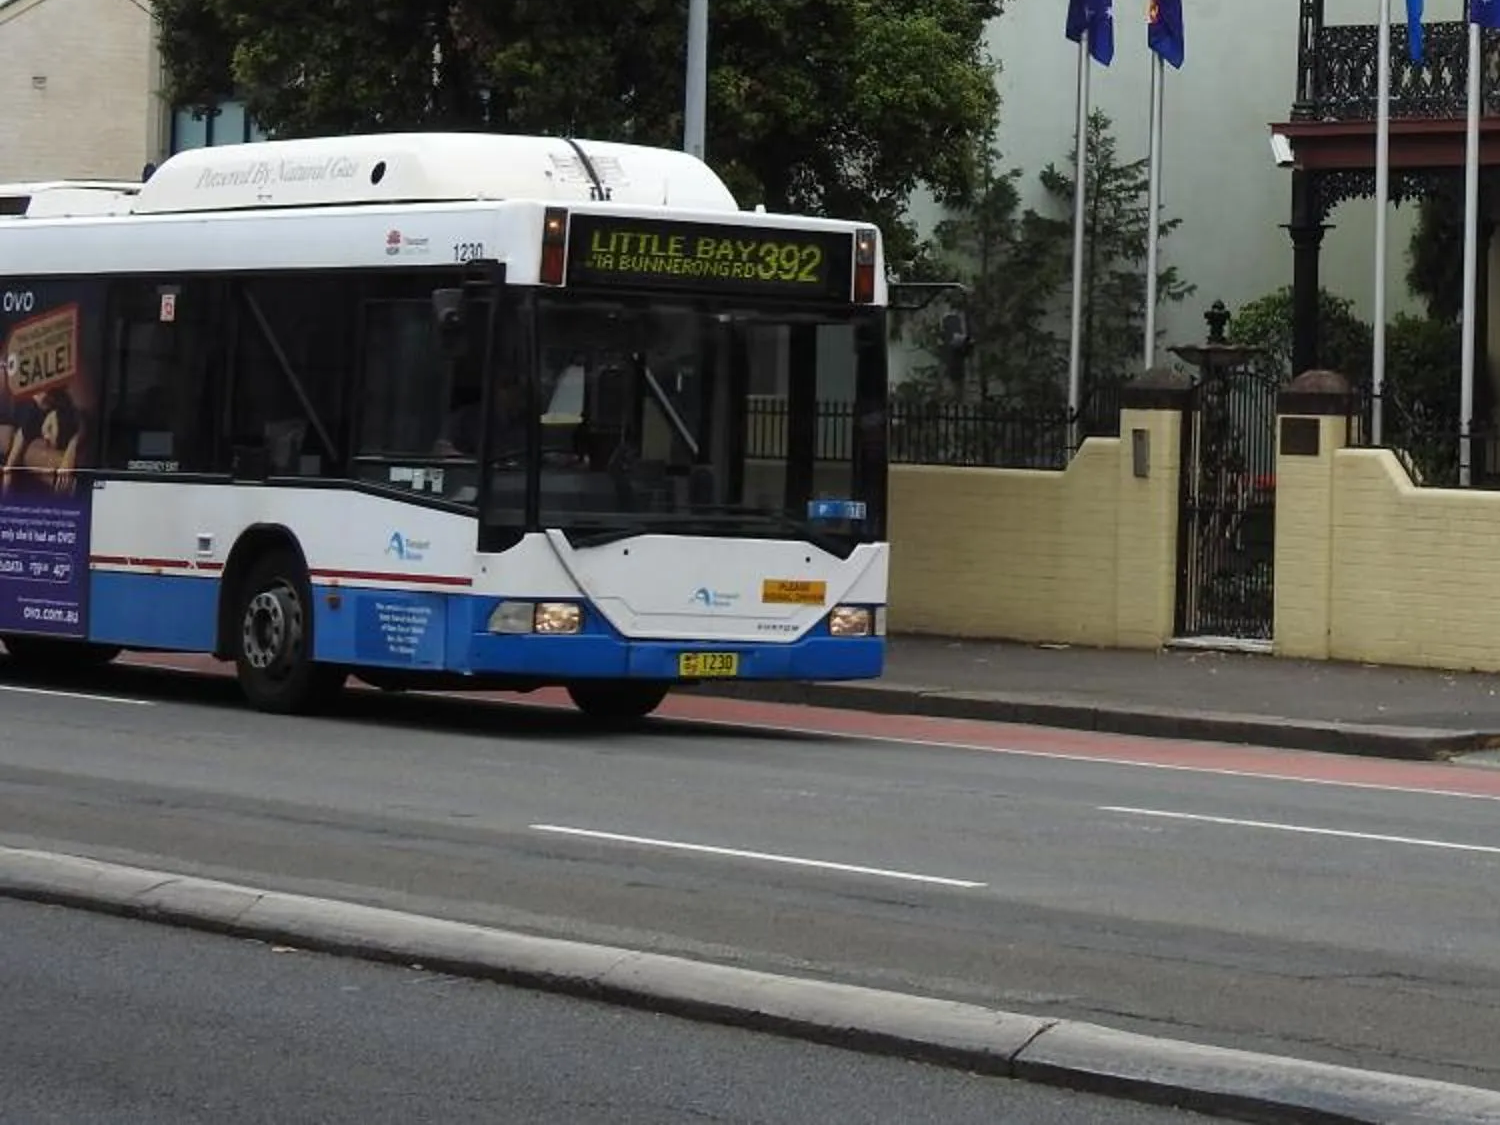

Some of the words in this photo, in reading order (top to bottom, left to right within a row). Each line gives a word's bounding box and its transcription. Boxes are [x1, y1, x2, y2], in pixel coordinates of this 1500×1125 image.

[453, 242, 483, 262] 1230
[591, 230, 686, 258] LITTLE
[697, 237, 757, 262] BAY
[757, 242, 822, 282] 392
[3, 291, 34, 312] OVO
[702, 654, 733, 671] 1230
